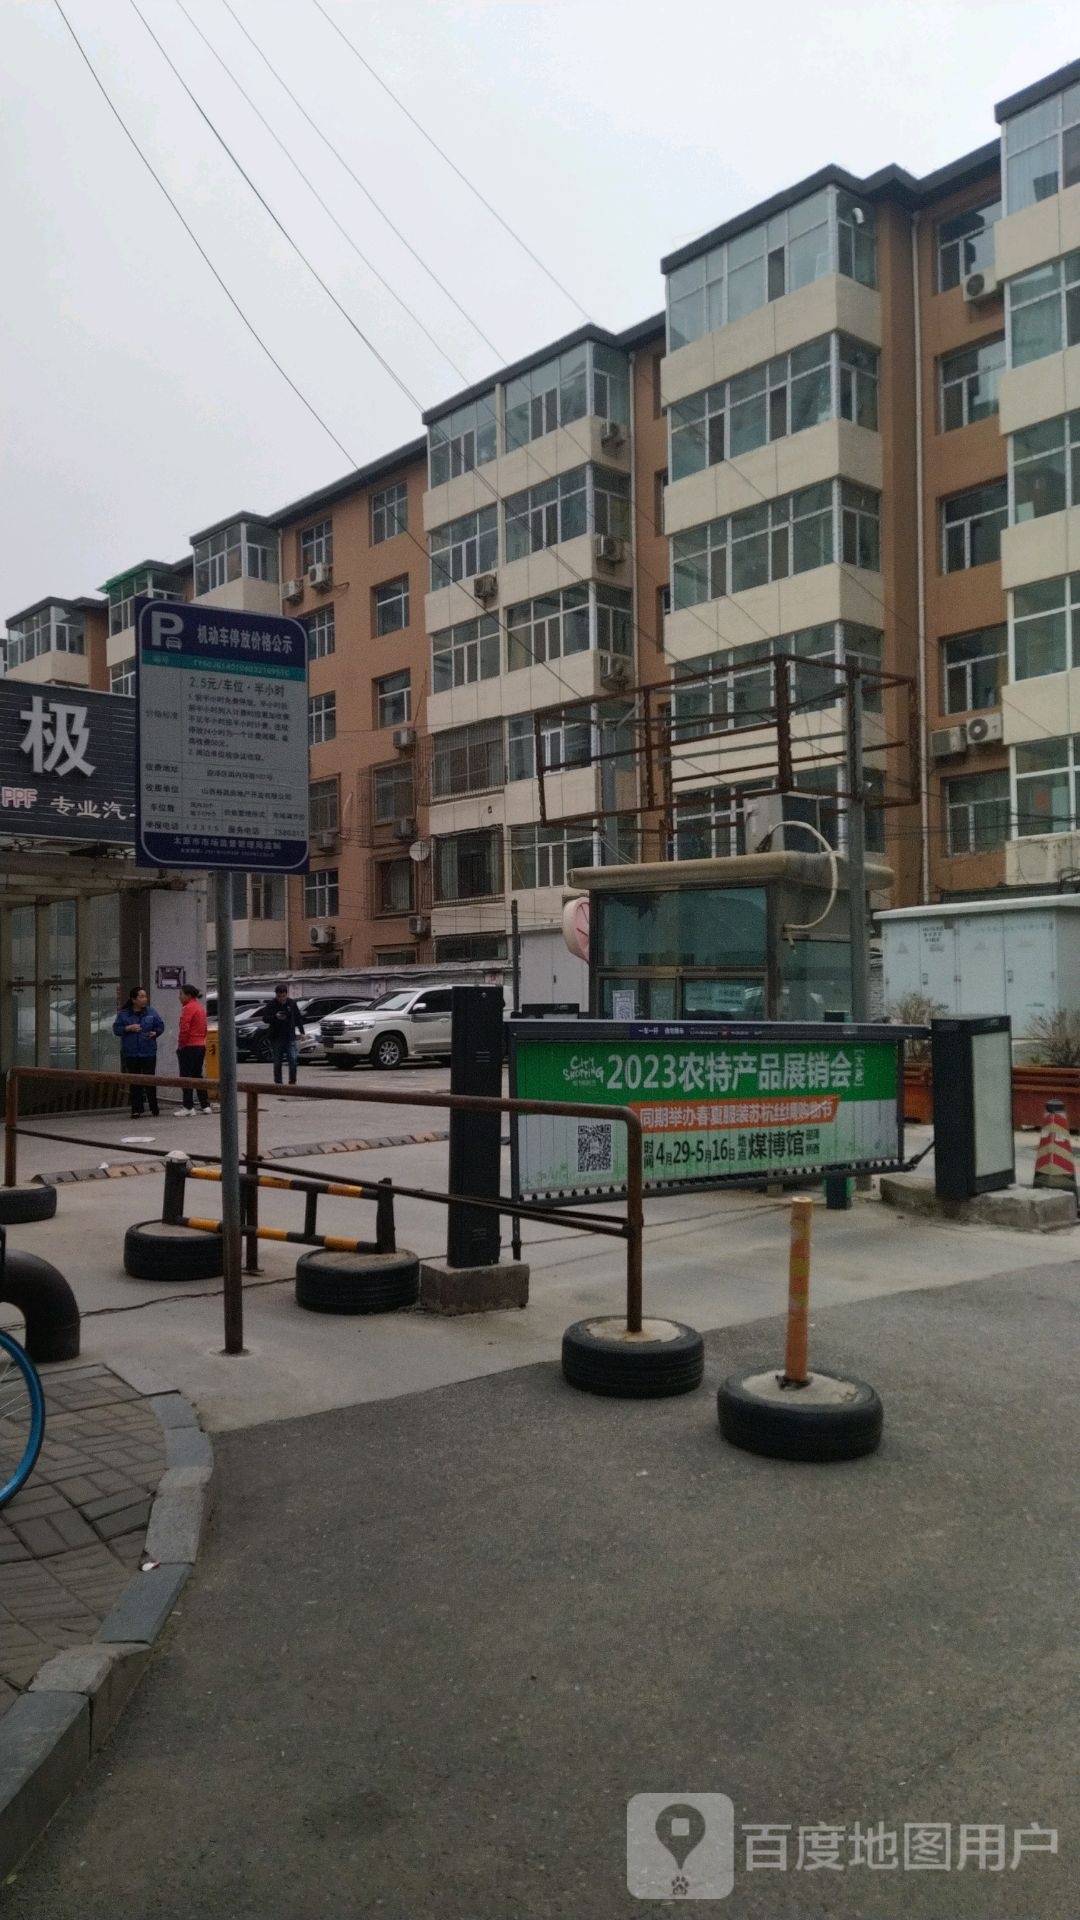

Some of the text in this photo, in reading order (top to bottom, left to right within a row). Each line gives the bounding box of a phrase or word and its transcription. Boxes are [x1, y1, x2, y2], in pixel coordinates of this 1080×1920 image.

[152, 611, 184, 646] P
[197, 624, 293, 654] 机动车停放价格公示
[20, 695, 97, 777] 极
[1, 786, 136, 820] PPF 专业汽
[606, 1051, 852, 1093] 2023农特产品展销会
[748, 1130, 804, 1160] 煤博馆
